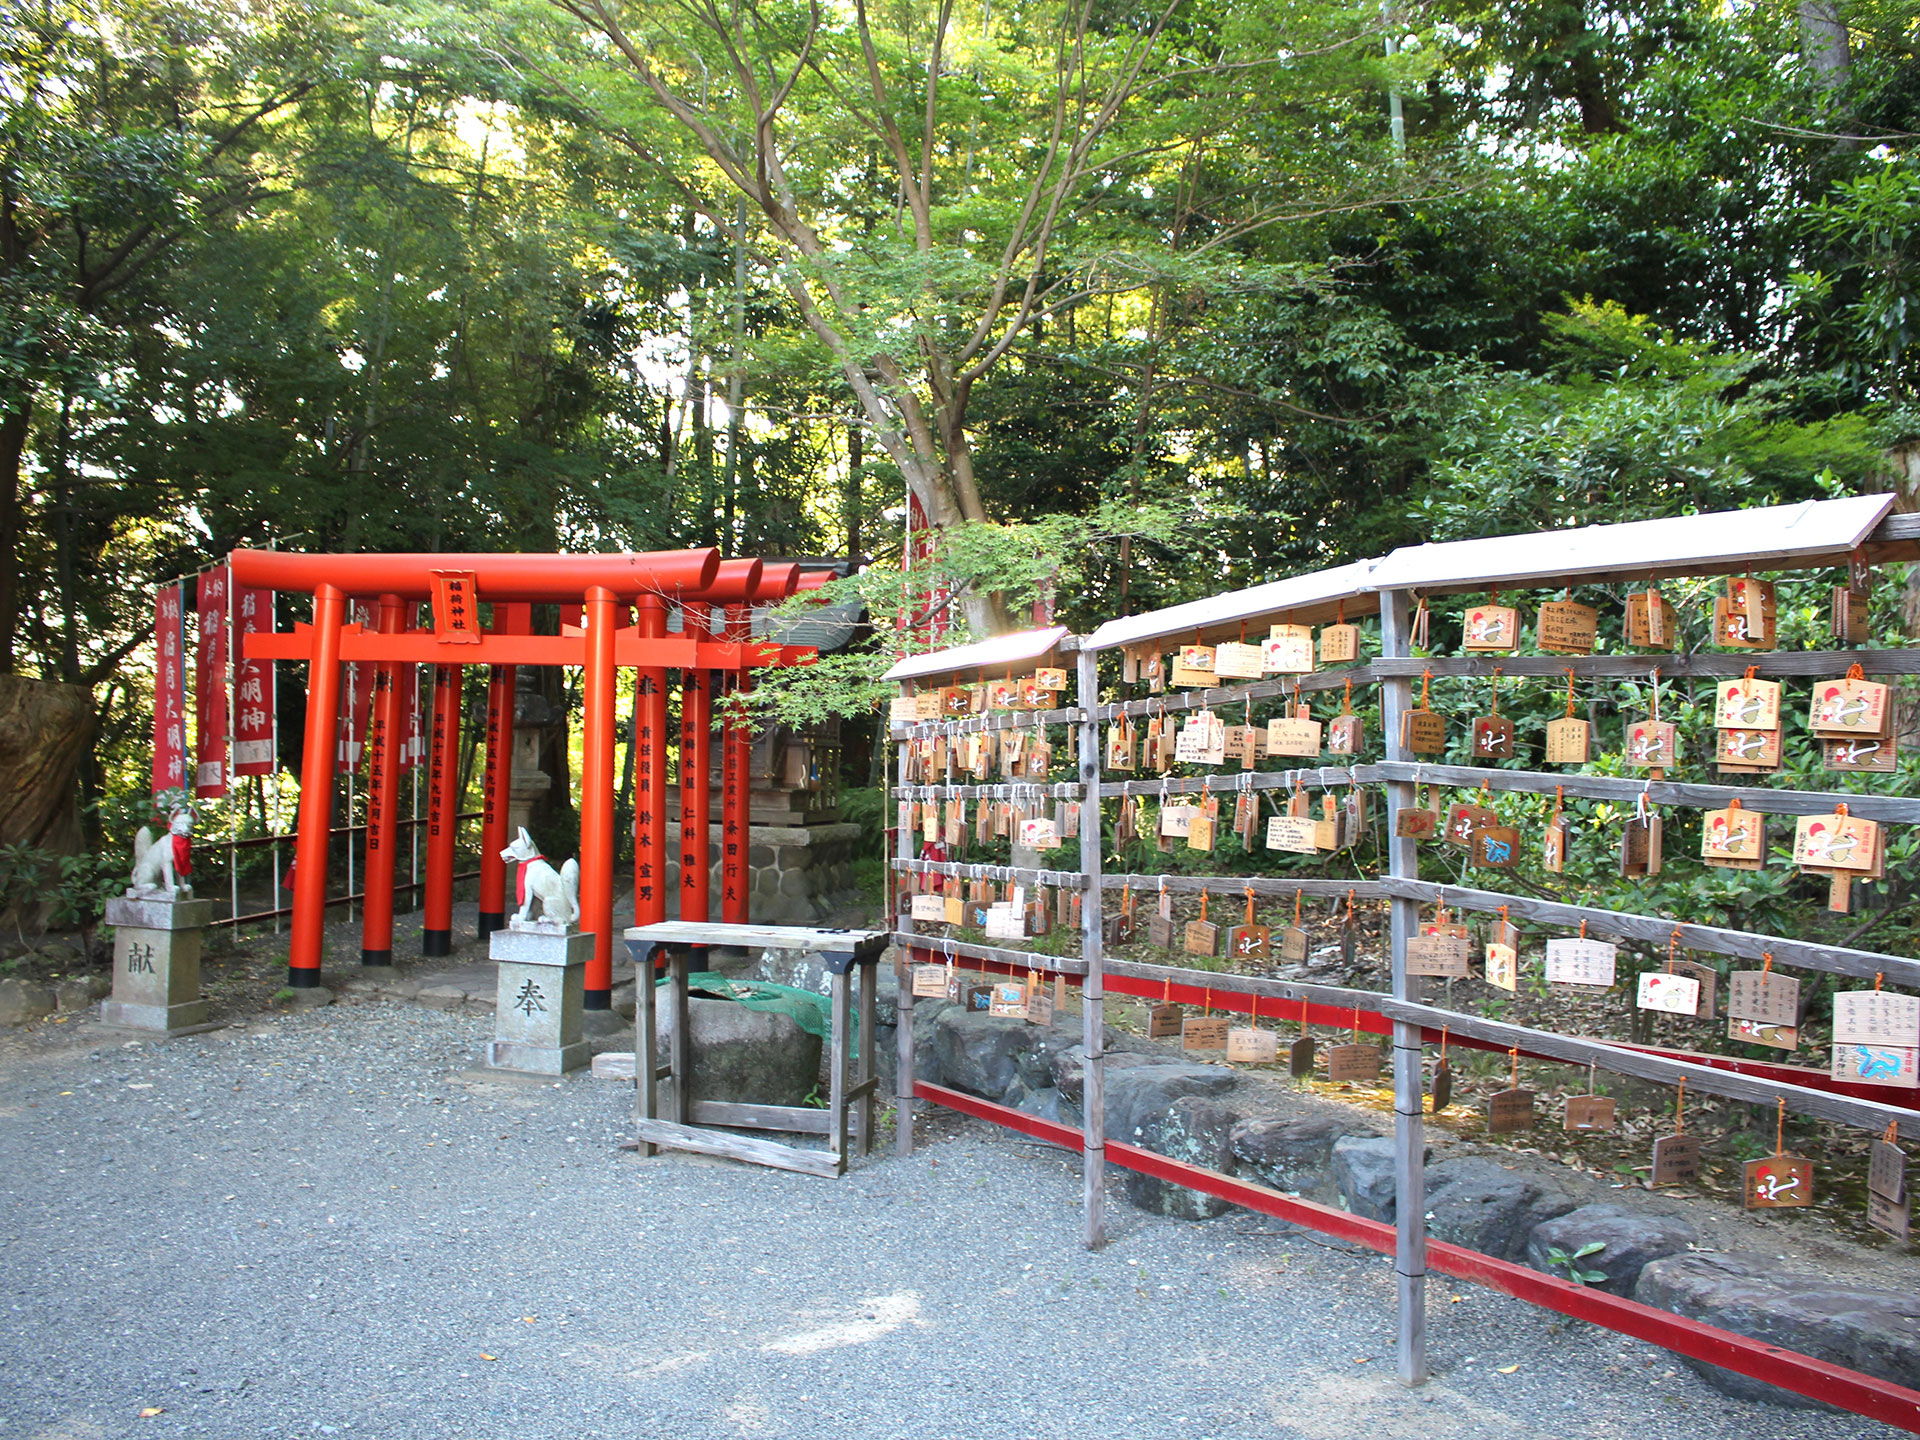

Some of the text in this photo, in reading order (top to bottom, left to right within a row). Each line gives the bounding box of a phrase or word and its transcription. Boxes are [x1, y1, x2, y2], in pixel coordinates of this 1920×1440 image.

[449, 581, 466, 630] 稲荷神社
[370, 720, 386, 849] 平成十五年九月吉日
[431, 713, 445, 836] 平成十五年九月吉日
[486, 708, 499, 824] 平成十五年九月吉日
[128, 942, 156, 974] 献
[513, 978, 548, 1017] 奉
